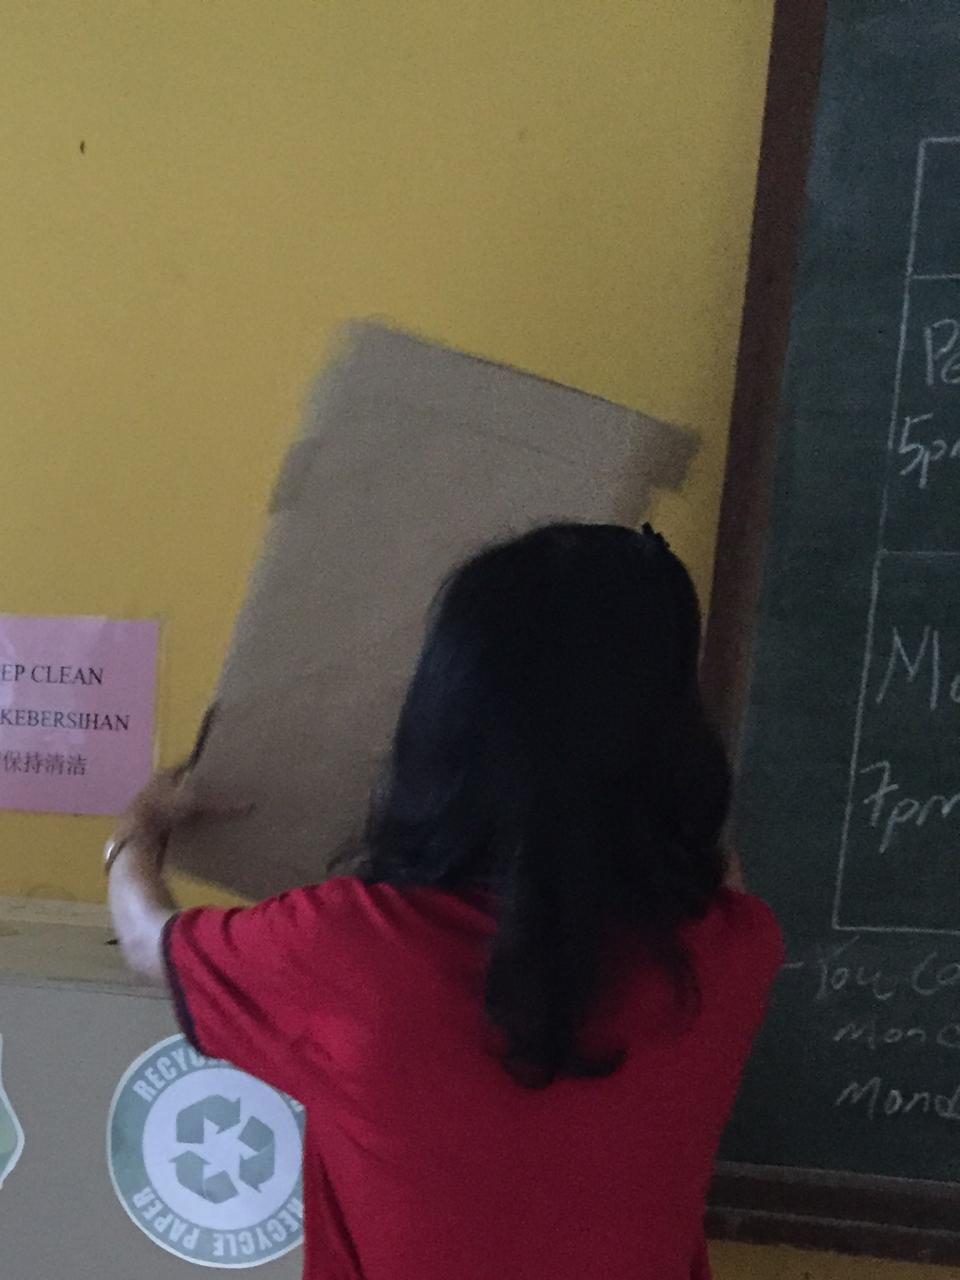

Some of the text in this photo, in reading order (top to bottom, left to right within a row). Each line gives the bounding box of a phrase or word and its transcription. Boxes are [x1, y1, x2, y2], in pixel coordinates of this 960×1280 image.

[31, 664, 104, 685] CLEAN
[0, 708, 131, 732] KEBERSIHAN
[133, 1187, 200, 1250] PAPER
